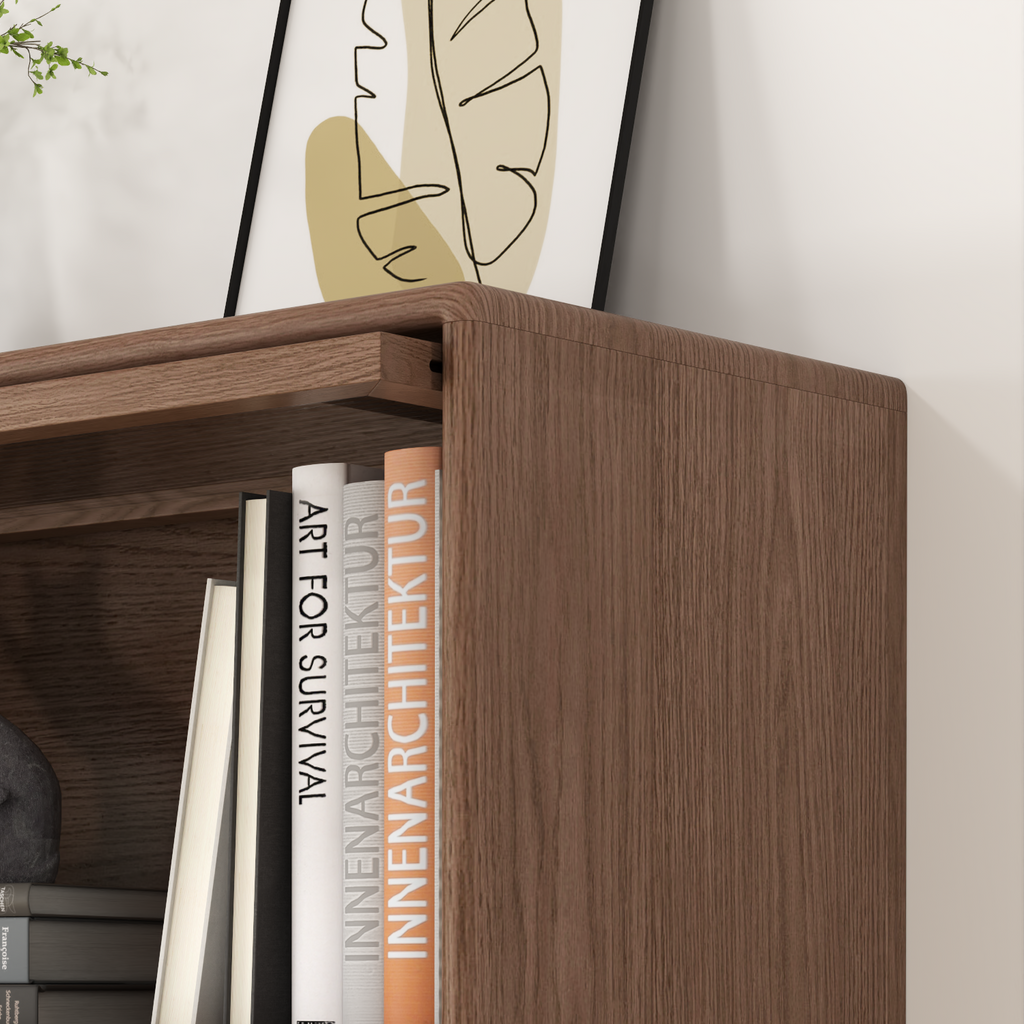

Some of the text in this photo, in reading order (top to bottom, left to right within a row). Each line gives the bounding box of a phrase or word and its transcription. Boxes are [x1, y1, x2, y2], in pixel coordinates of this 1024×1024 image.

[298, 499, 329, 805] ART FOR SURVIVAL
[344, 513, 380, 962] INNENARCHITEKTUR
[387, 479, 428, 959] INNENARCHITEKTUR
[0, 926, 10, 971] Françoise
